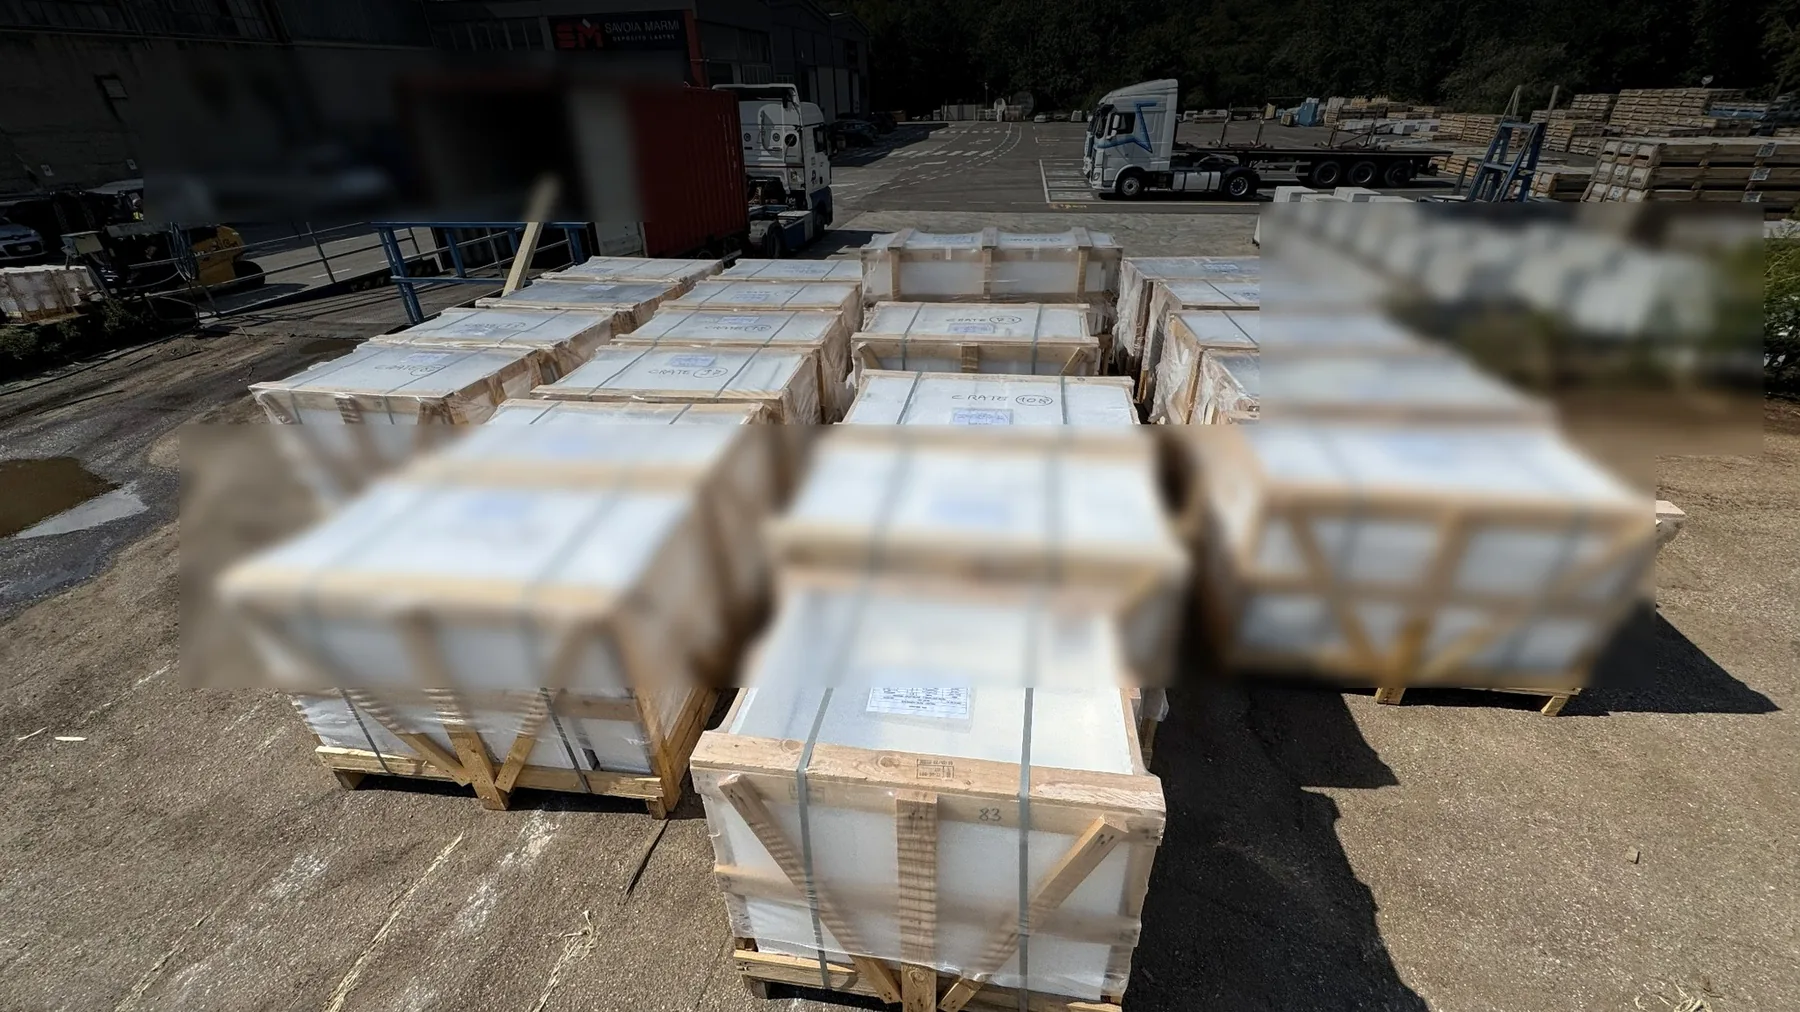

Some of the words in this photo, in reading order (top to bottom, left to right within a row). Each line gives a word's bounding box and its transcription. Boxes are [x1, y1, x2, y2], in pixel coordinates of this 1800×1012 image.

[604, 21, 642, 34] SAVOIA
[644, 19, 680, 32] MARMI
[951, 394, 1008, 402] CRATE
[978, 807, 1002, 822] 83
